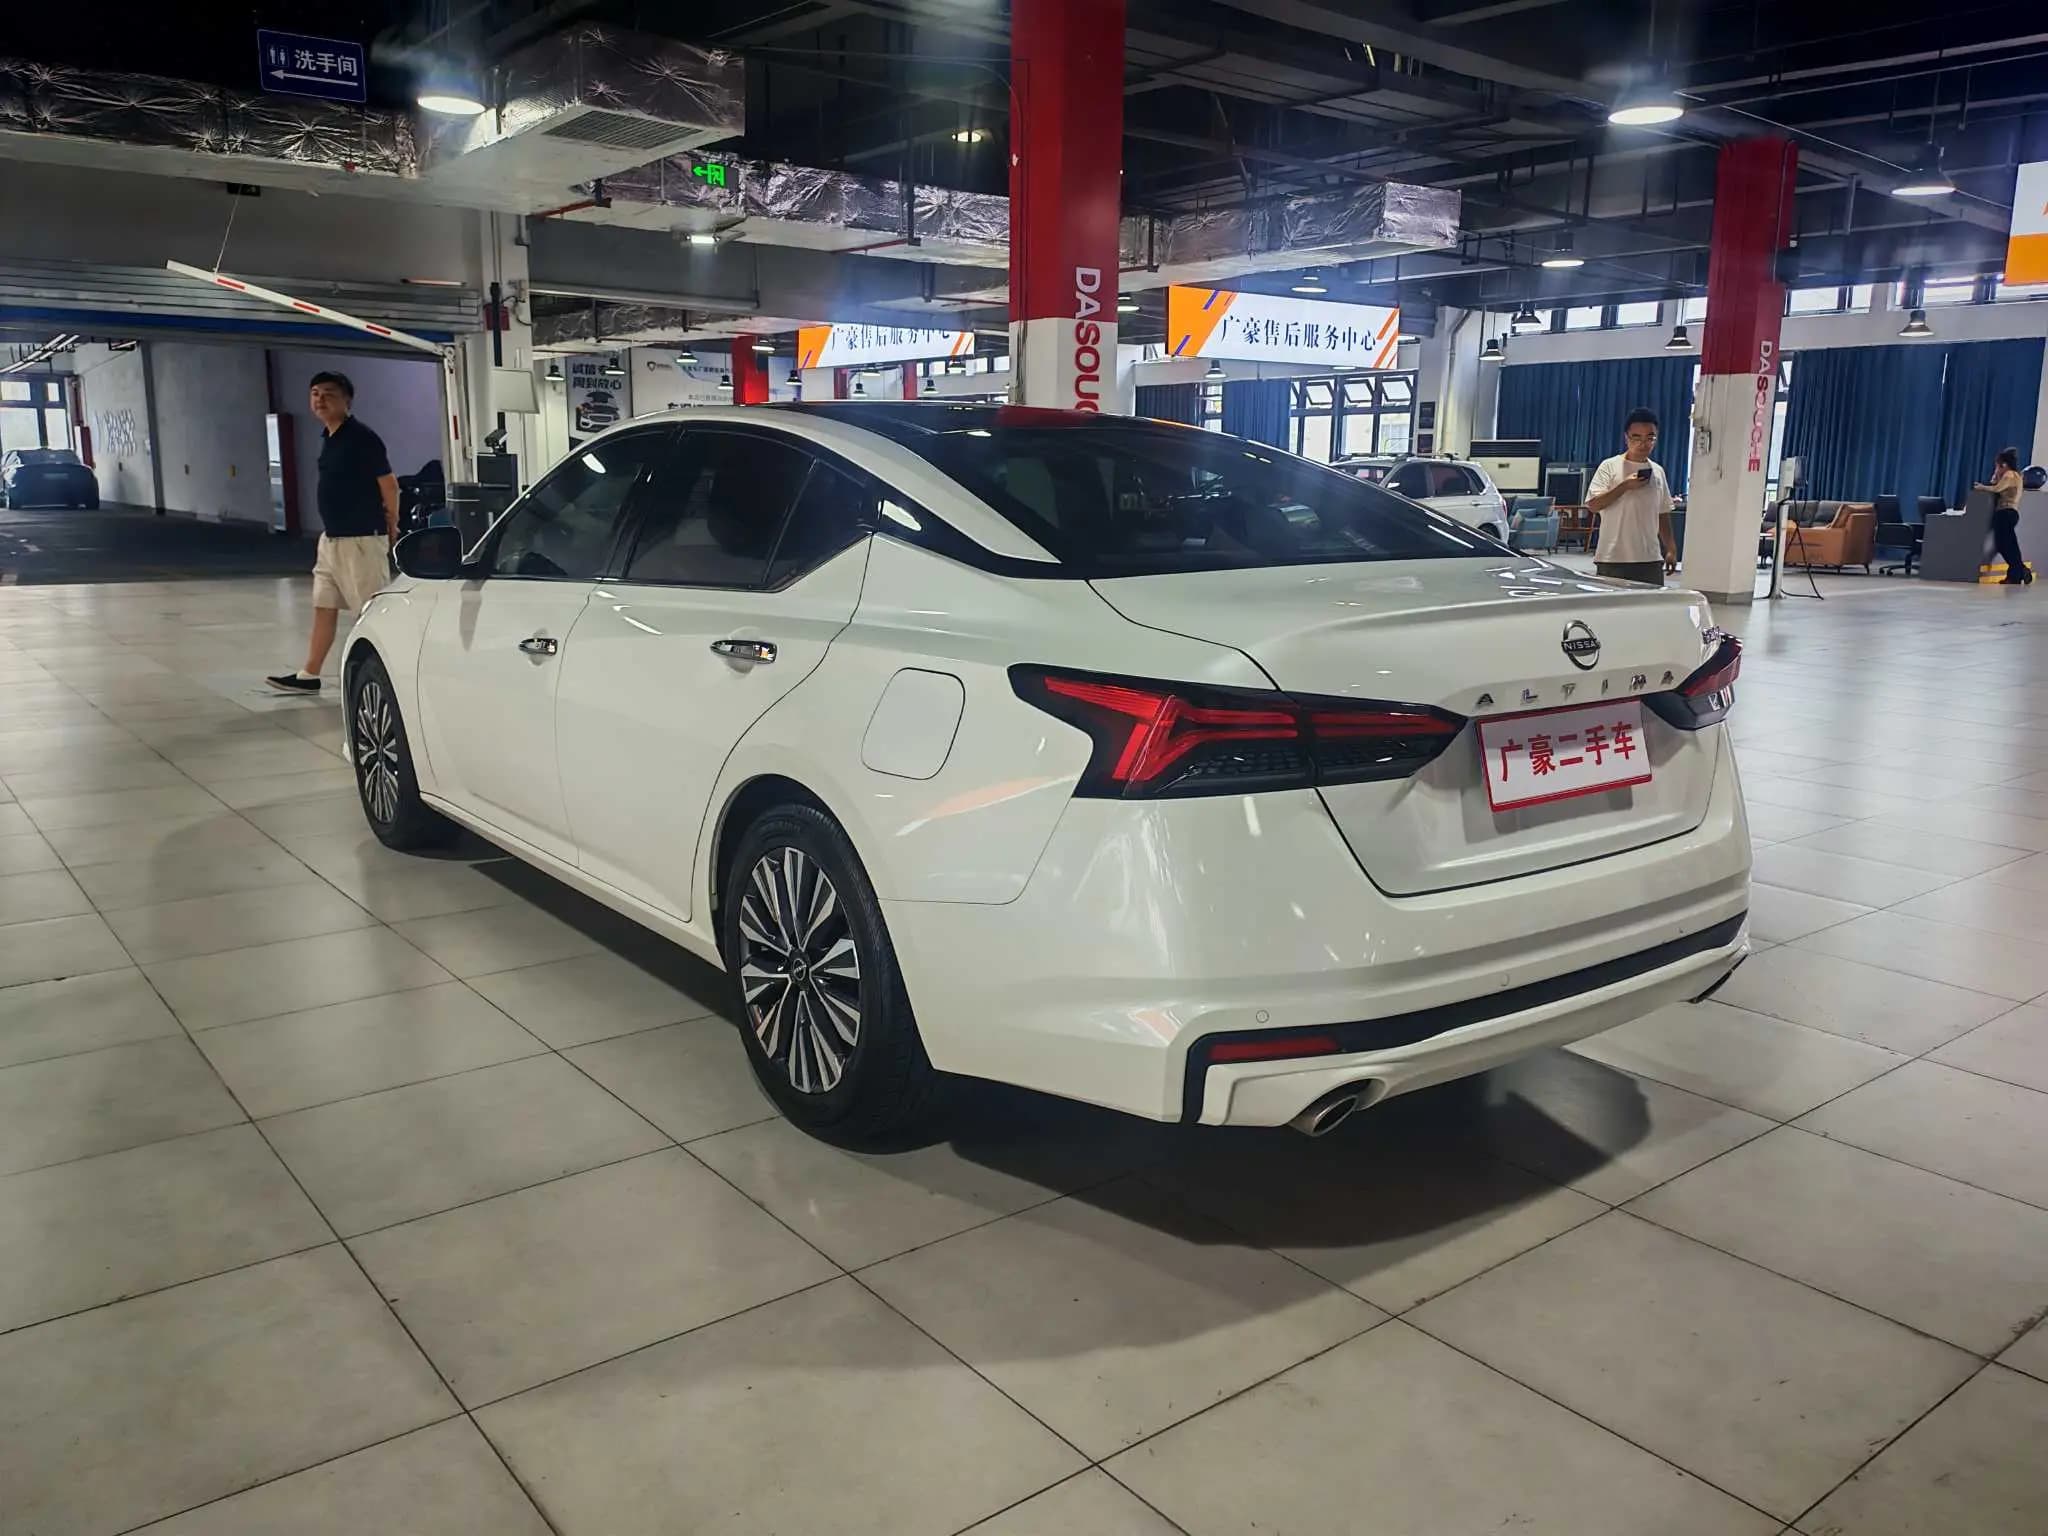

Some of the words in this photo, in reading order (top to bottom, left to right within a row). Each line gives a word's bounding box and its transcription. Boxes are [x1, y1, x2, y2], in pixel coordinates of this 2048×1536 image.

[294, 49, 358, 76] 洗手间
[1221, 315, 1376, 351] 广豪售后服务中心
[572, 363, 613, 376] 诚信专
[1748, 340, 1773, 472] DASOUCHE
[1477, 670, 1675, 706] ALTIMA
[1500, 720, 1636, 782] 广豪二手车
